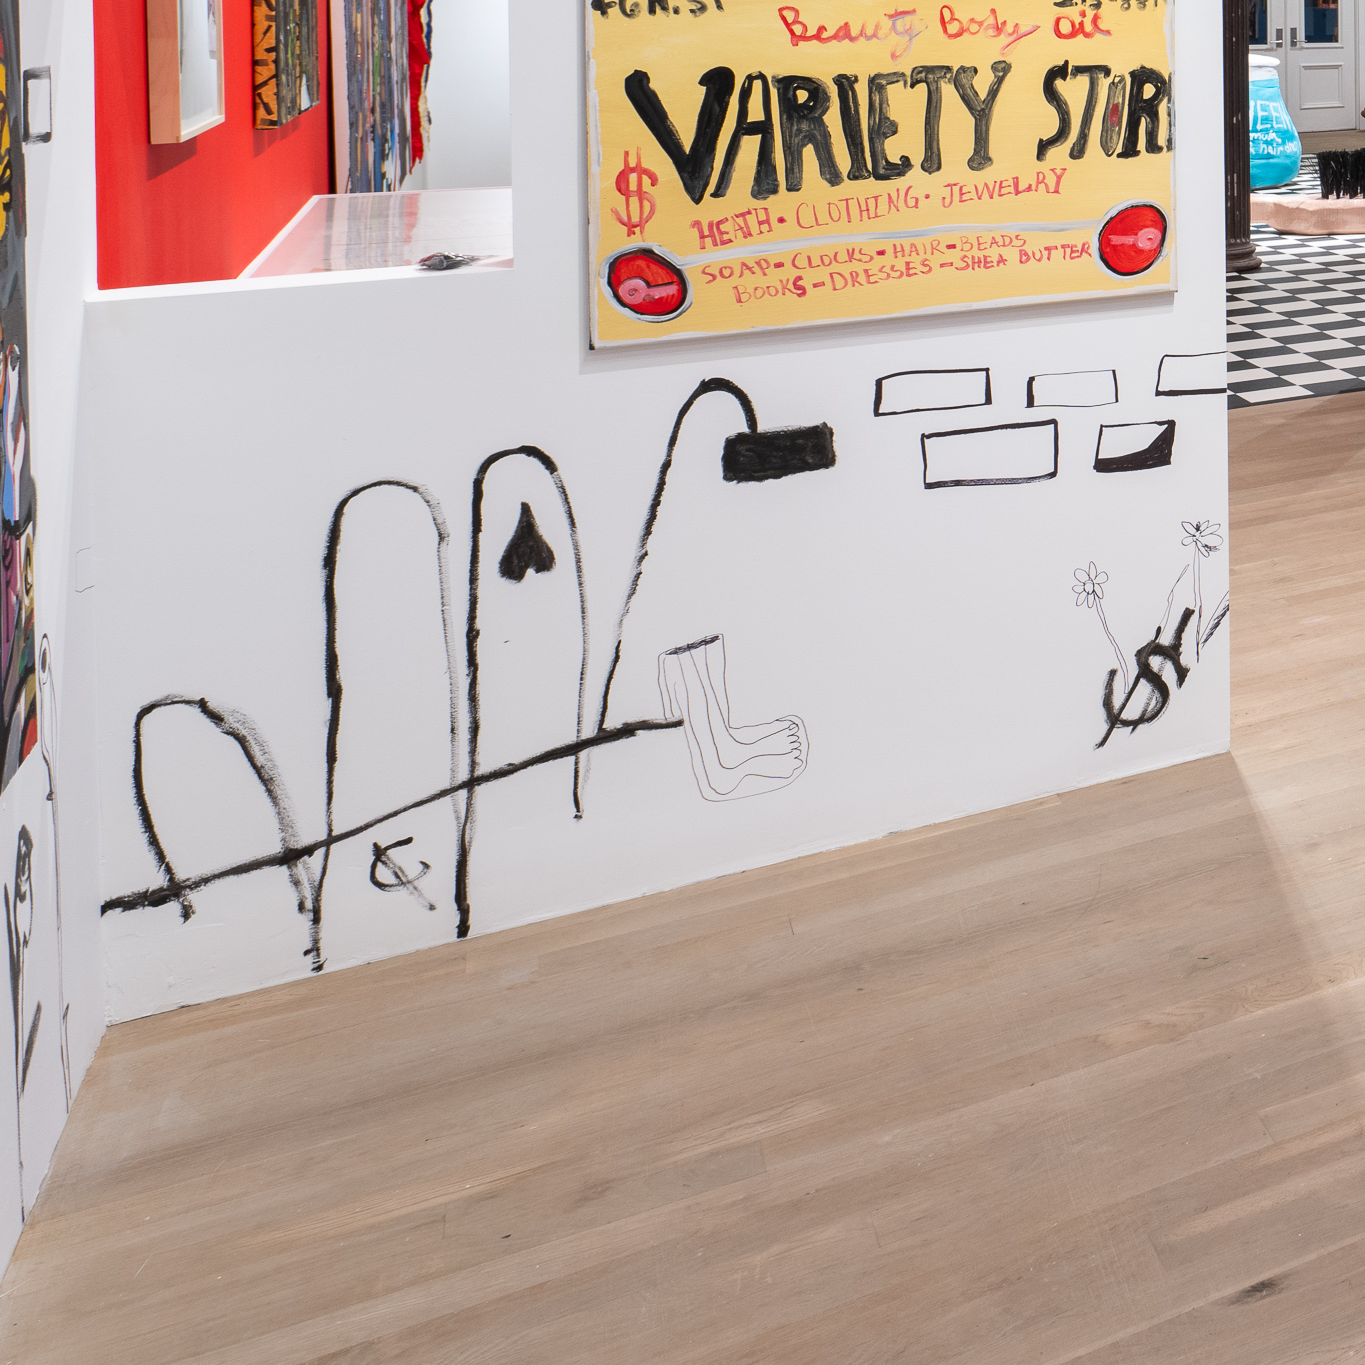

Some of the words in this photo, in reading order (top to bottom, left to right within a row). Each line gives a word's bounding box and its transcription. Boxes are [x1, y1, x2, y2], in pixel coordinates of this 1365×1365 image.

[778, 5, 929, 64] Beauty
[940, 4, 1042, 57] Body
[625, 60, 1013, 206] VARIETY
[941, 167, 1068, 208] JEWELRY
[1018, 241, 1093, 266] BUTTER
